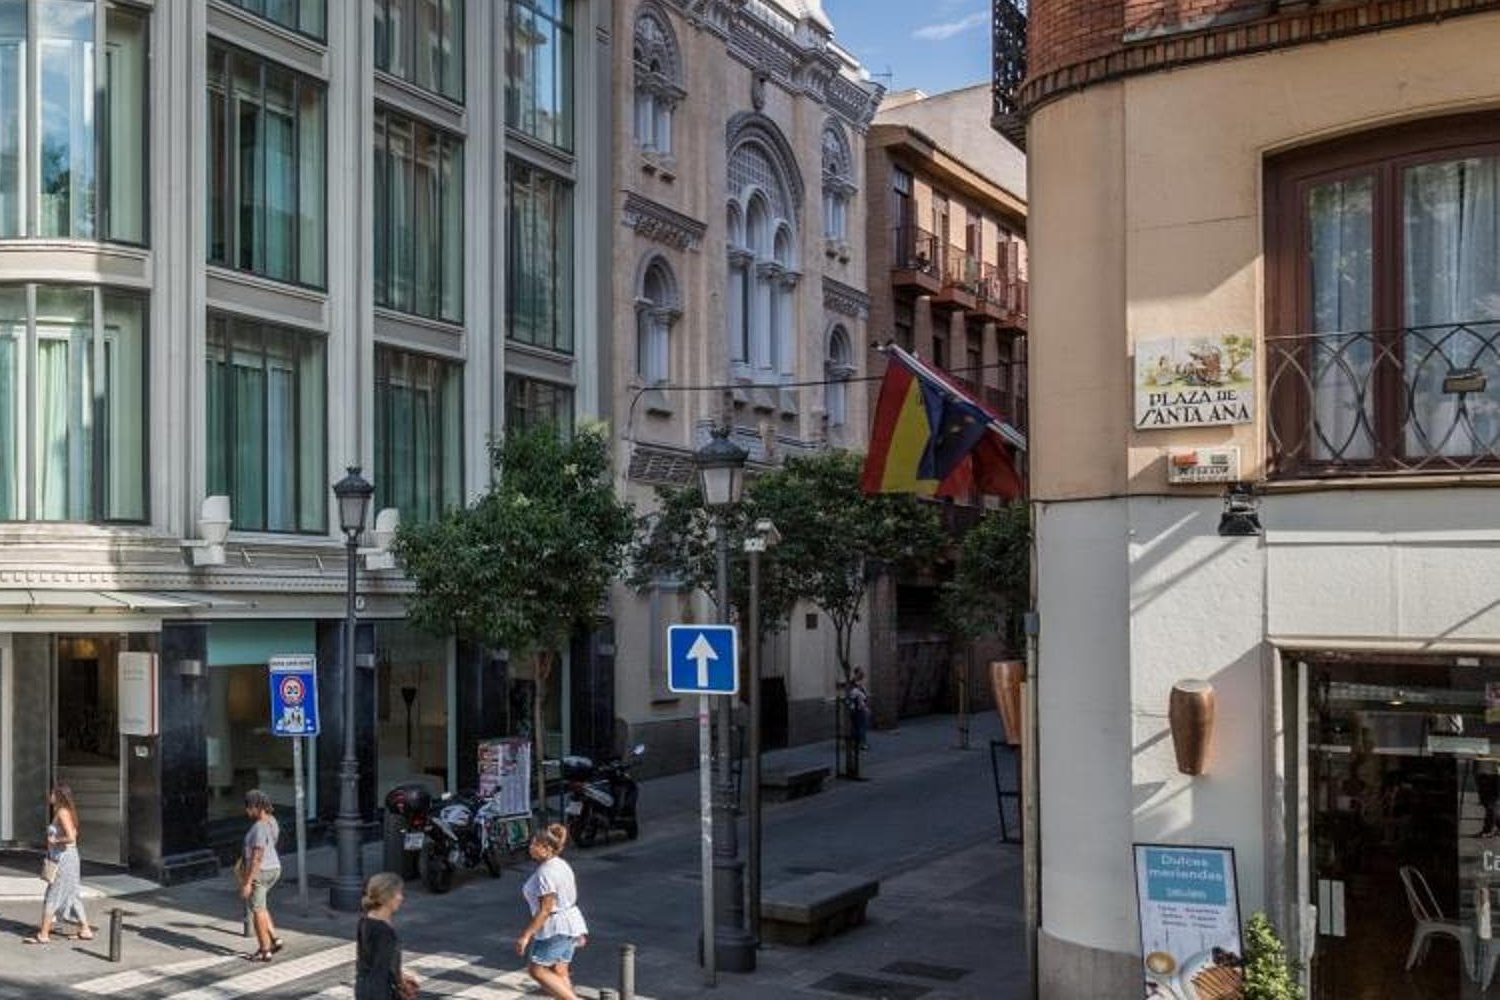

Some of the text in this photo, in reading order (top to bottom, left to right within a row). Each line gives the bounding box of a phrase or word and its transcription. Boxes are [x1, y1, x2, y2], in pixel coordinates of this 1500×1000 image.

[1149, 389, 1237, 407] PLAZA DE
[1139, 402, 1250, 427] SANTA ANA
